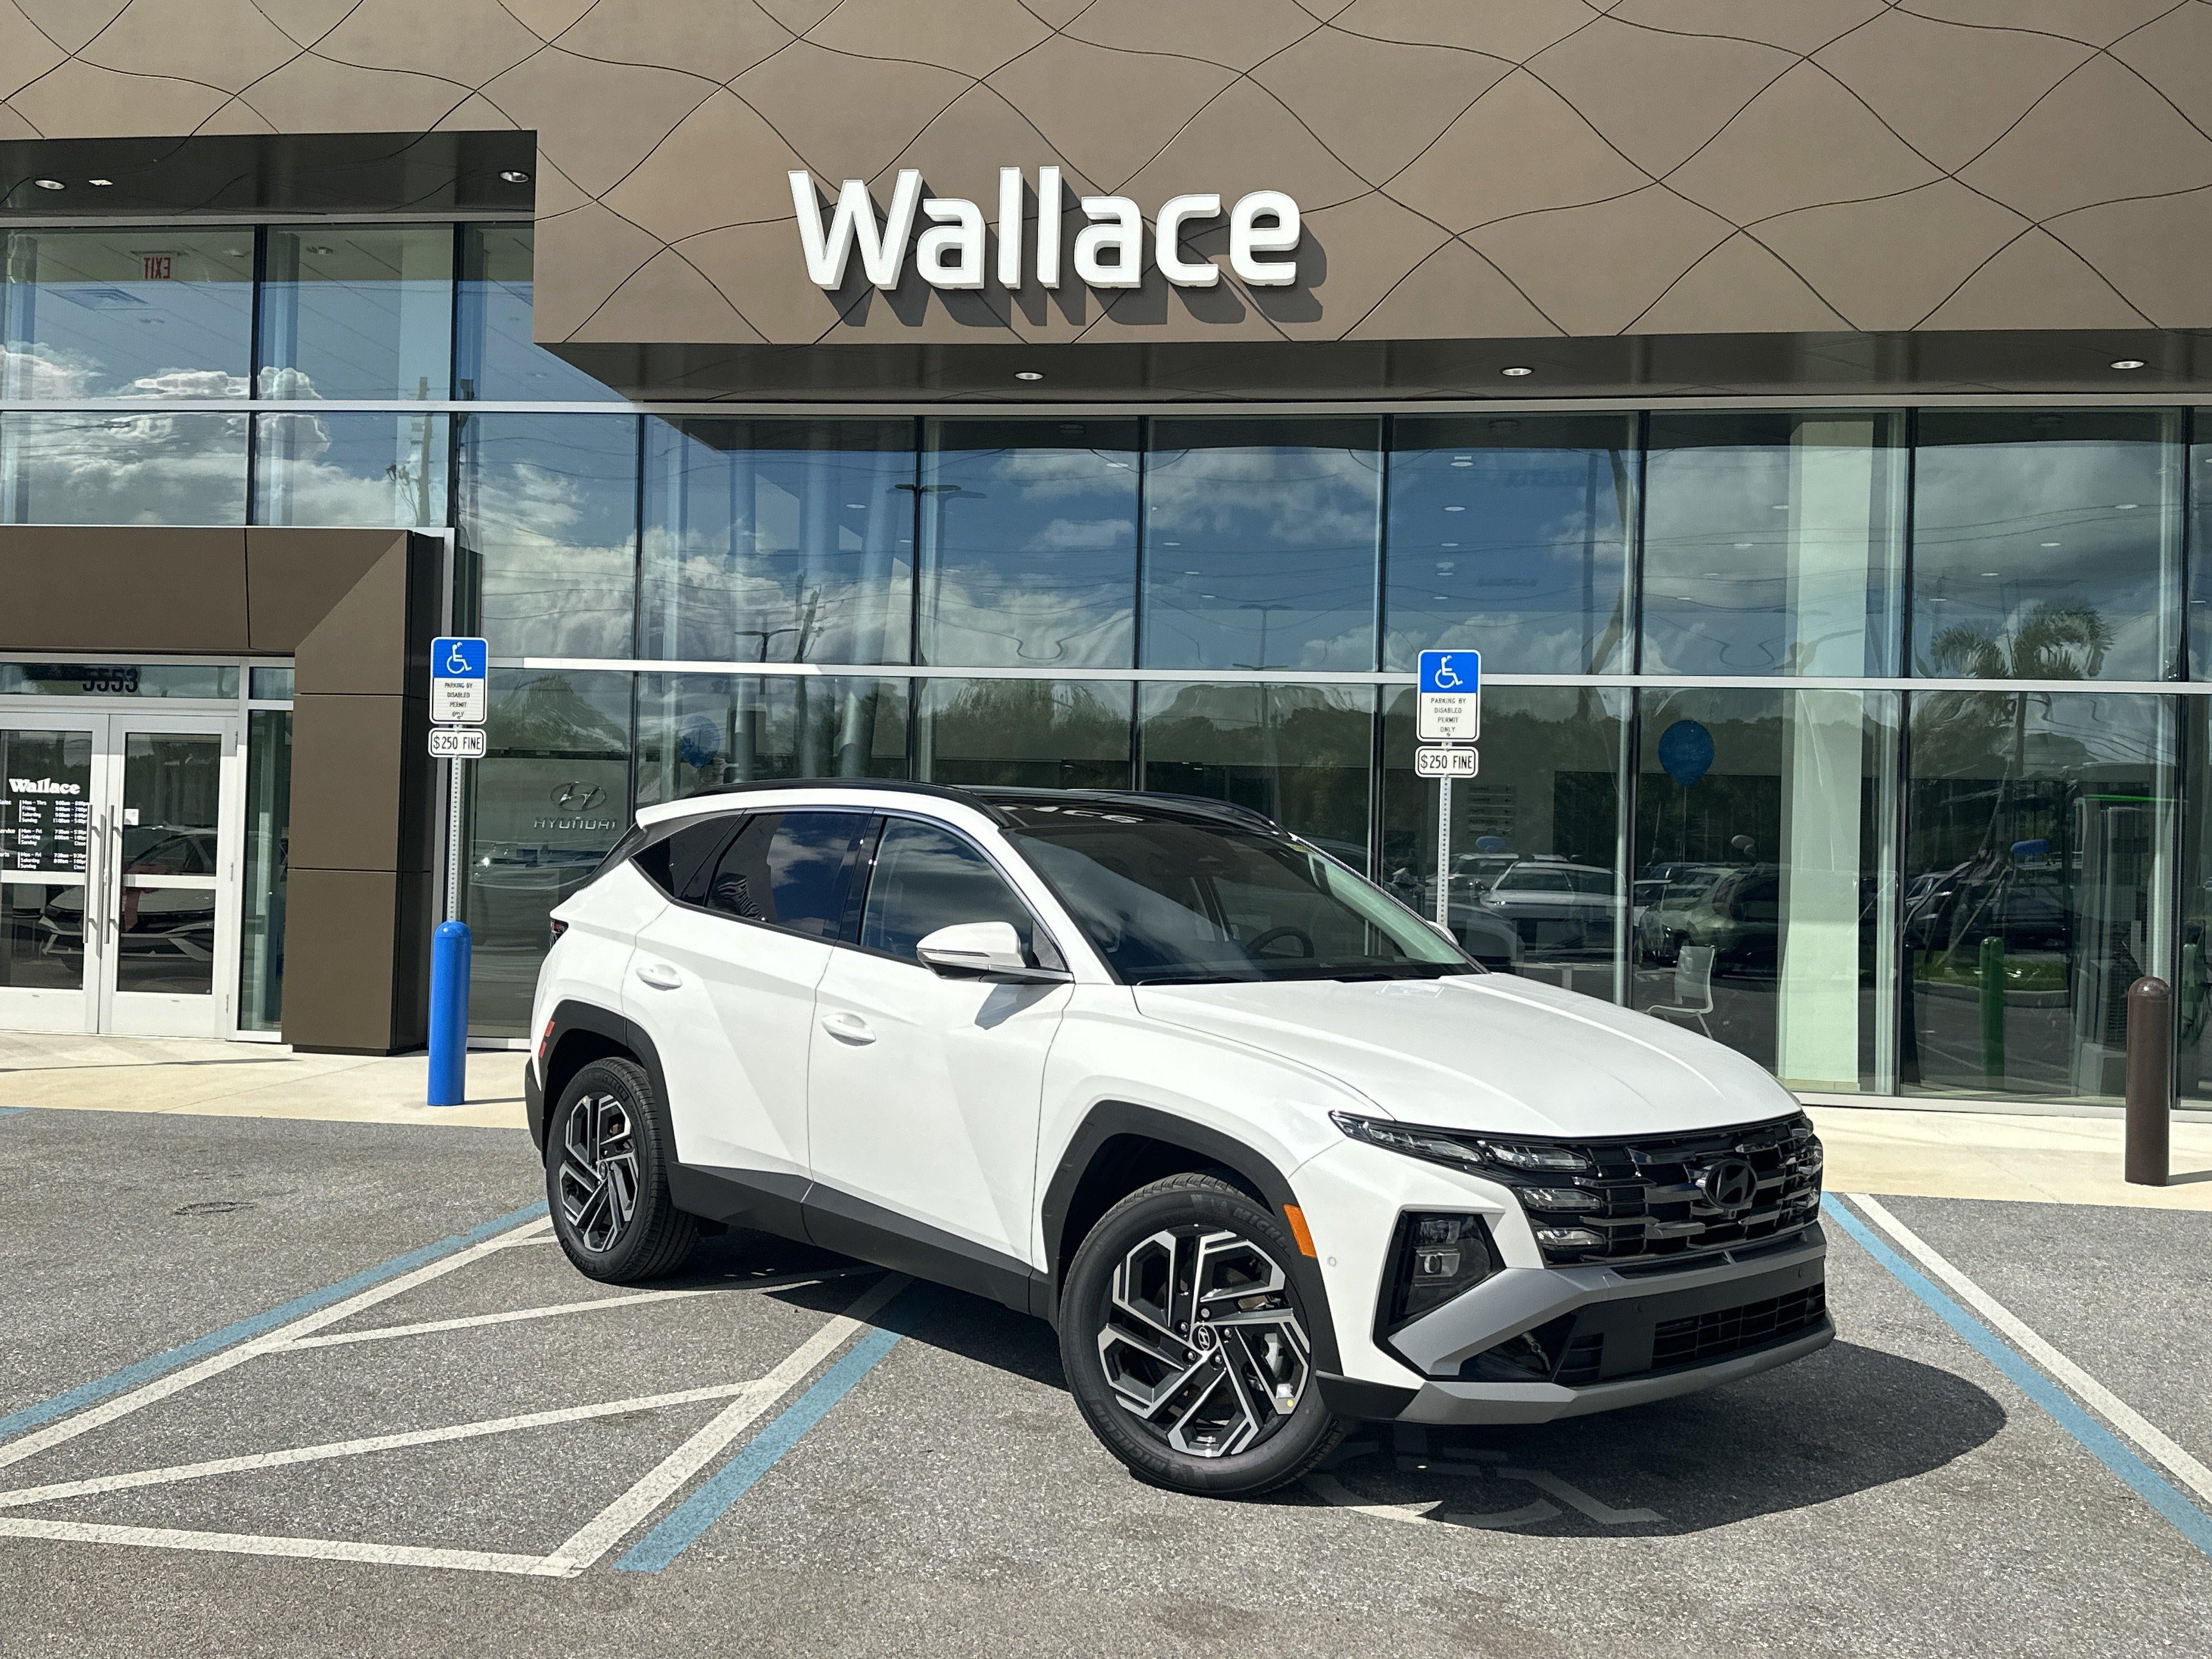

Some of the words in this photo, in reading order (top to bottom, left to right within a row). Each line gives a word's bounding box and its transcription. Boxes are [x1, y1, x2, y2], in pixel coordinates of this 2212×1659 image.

[787, 166, 1300, 290] Wallace
[433, 735, 458, 750] $250
[463, 737, 481, 749] FINE
[1420, 754, 1447, 770] $250
[1453, 755, 1472, 769] FINE
[9, 778, 80, 794] Wallace
[534, 816, 616, 830] HYUNDAI
